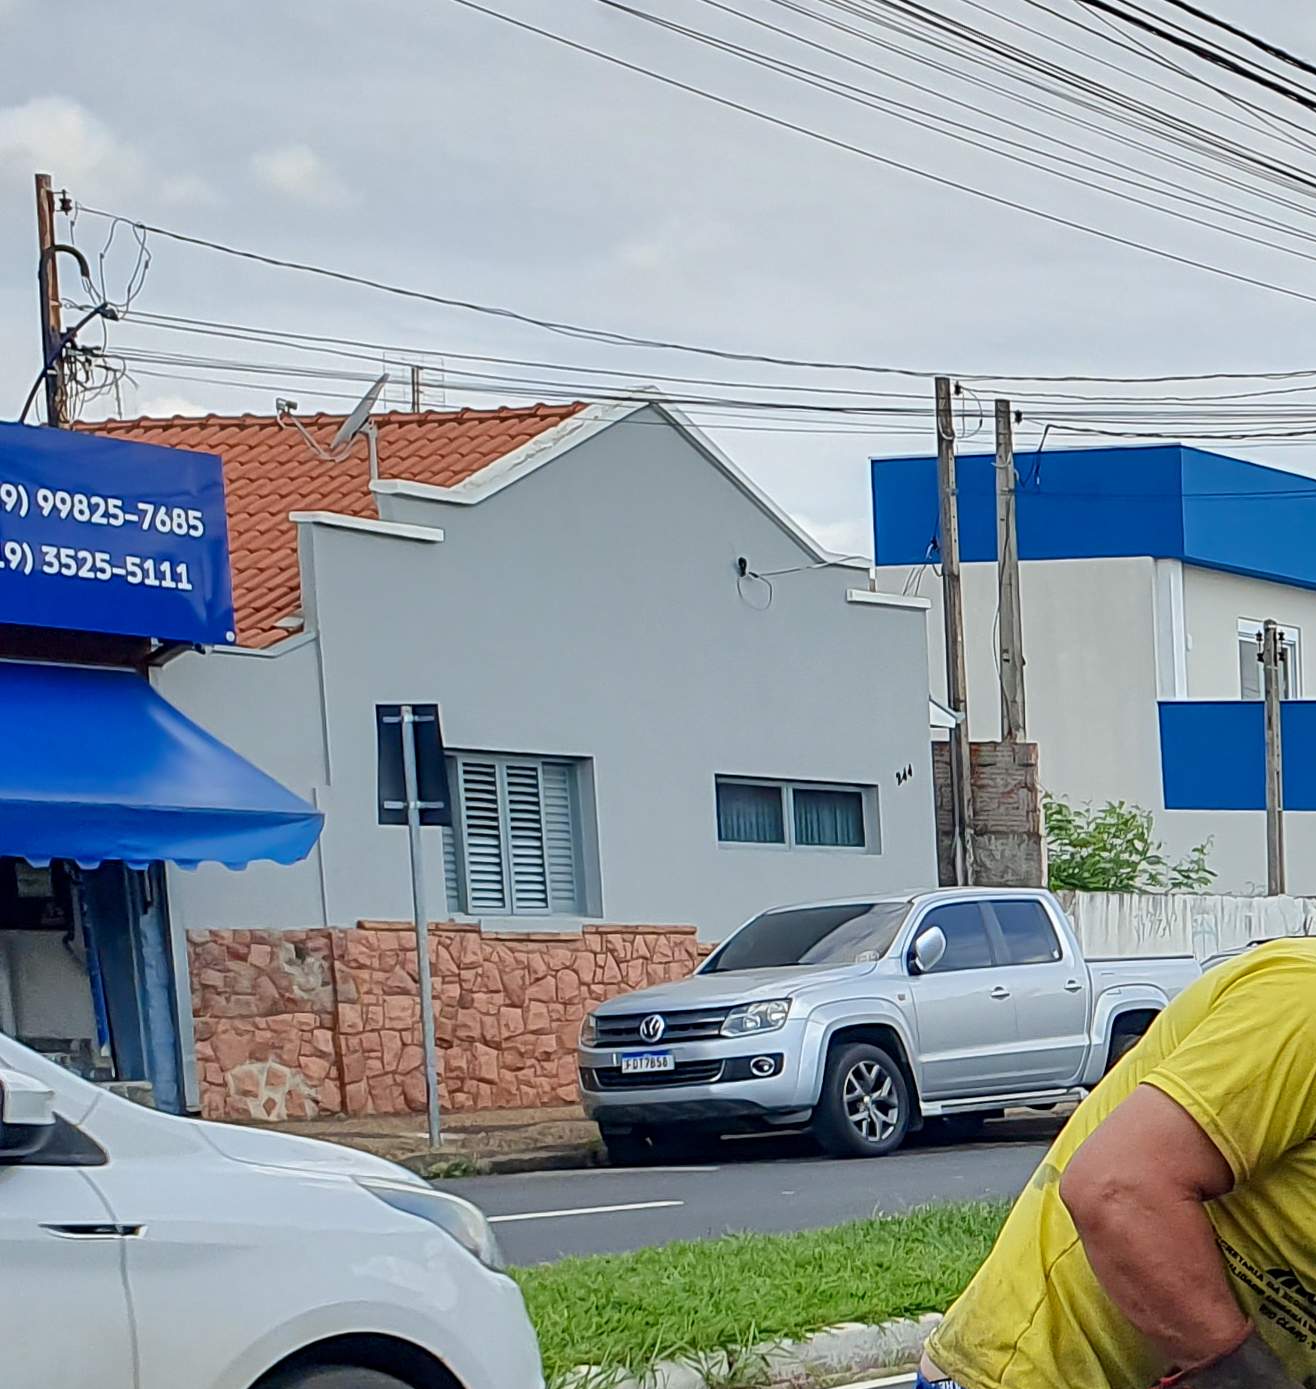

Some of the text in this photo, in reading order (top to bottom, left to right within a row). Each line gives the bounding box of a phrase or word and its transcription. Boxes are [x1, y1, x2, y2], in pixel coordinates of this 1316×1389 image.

[37, 487, 204, 538] 99825-7685
[0, 541, 193, 590] 9) 3525-5111
